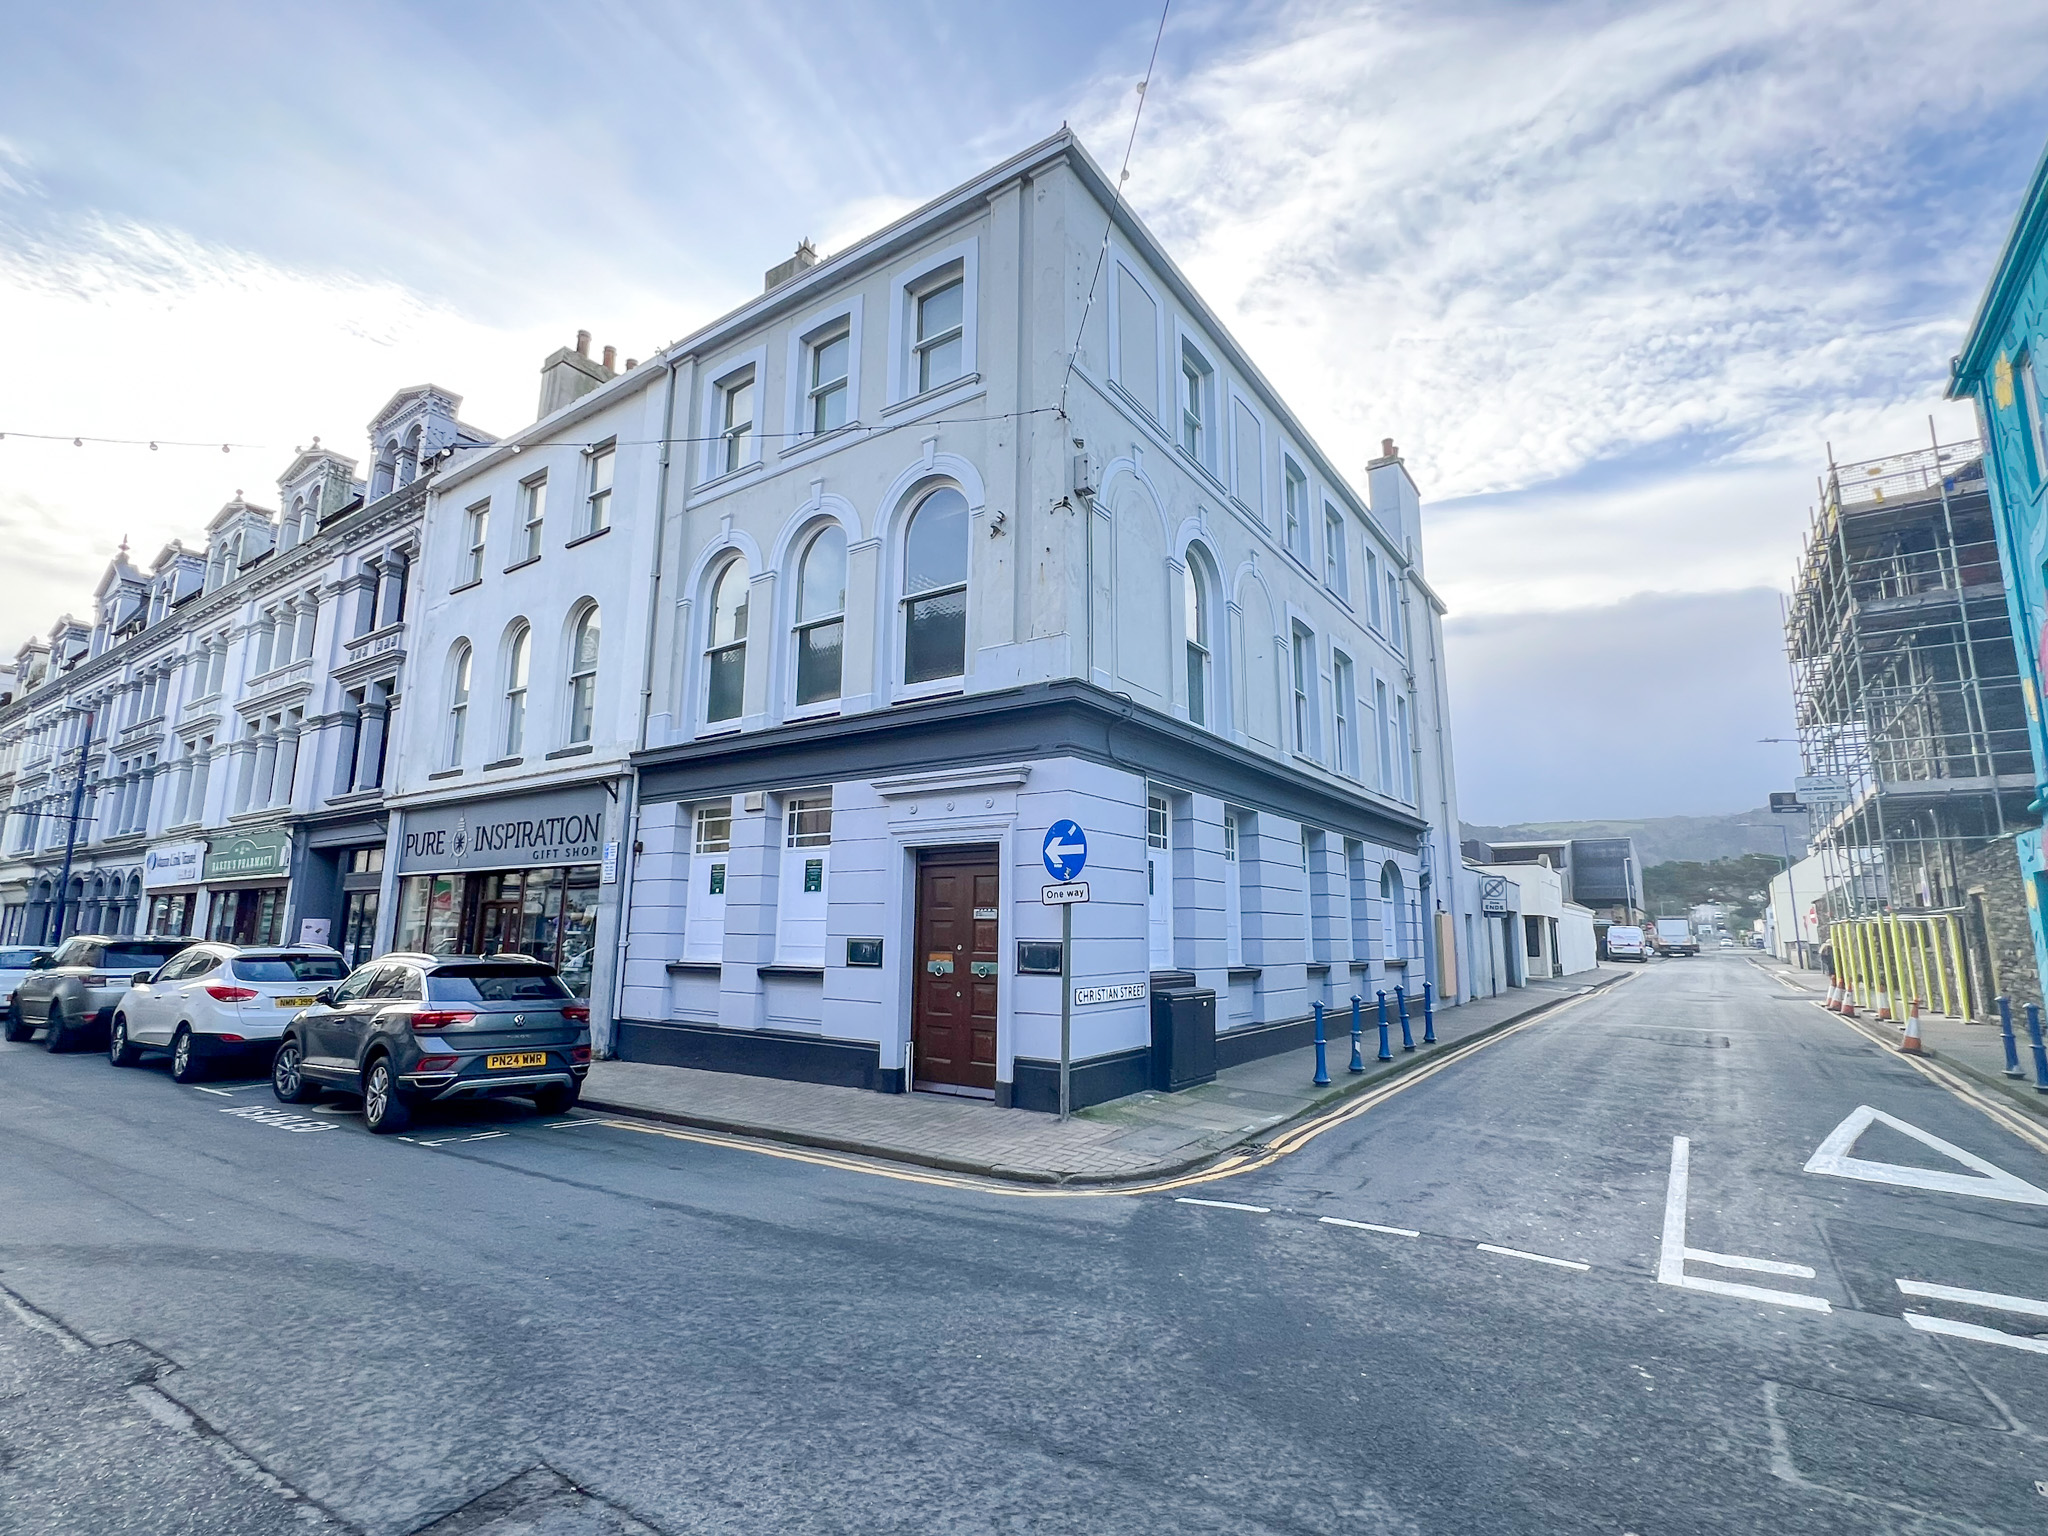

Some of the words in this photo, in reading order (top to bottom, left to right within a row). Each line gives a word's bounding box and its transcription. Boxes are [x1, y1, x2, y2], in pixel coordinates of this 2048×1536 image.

[405, 831, 446, 857] PURE
[473, 813, 601, 852] INSPIRATION
[533, 849, 558, 860] GIFT
[565, 846, 598, 857] SHOP
[238, 855, 273, 869] PHARMACY
[1046, 890, 1064, 899] One
[1066, 889, 1084, 898] way
[1077, 988, 1119, 1002] CHRISTIAN
[1120, 985, 1144, 998] STREET
[492, 1055, 520, 1066] PN24
